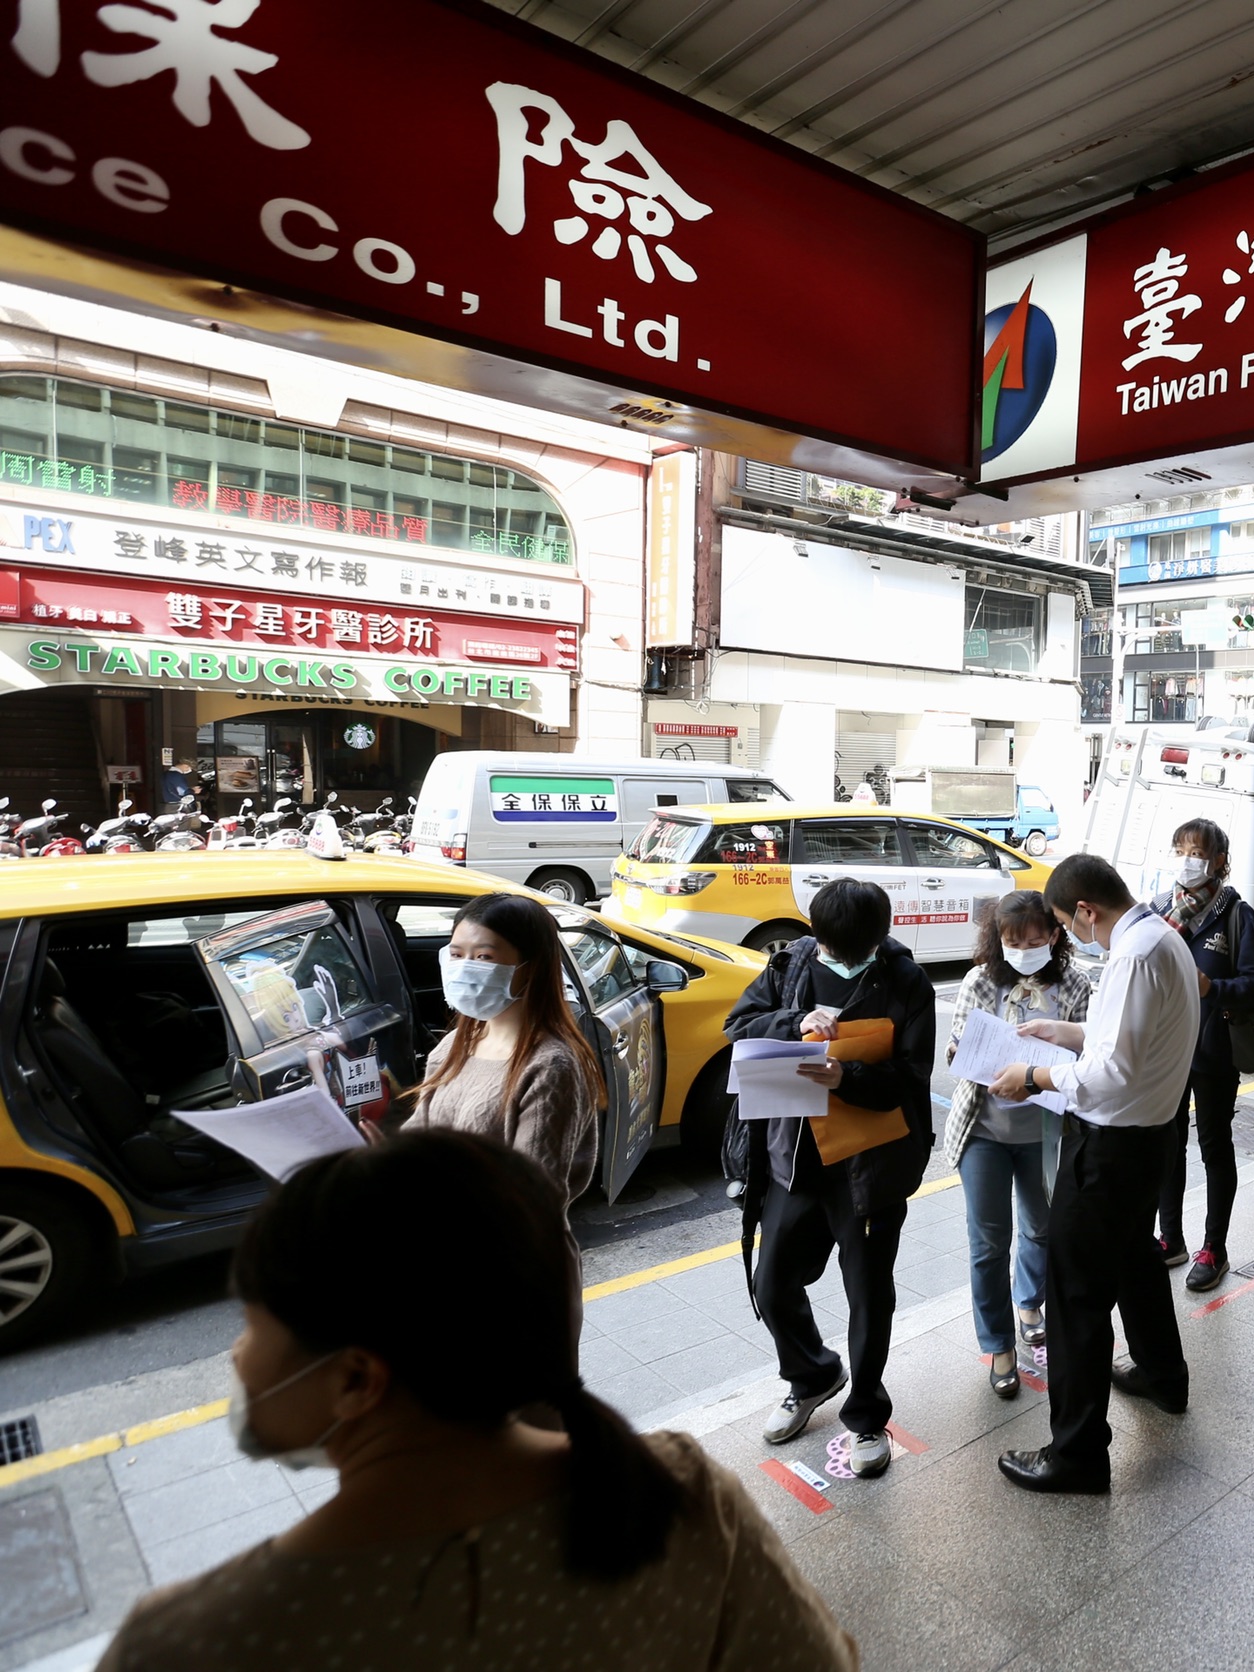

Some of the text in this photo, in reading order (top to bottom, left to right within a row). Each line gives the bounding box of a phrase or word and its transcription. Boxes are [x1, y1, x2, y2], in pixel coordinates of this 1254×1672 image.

[260, 199, 480, 315] Co.,
[545, 278, 711, 372] Ltd.
[1117, 366, 1228, 416] Taiwan
[113, 529, 368, 588] 登峰英文寫作報
[470, 530, 569, 563] 全民健保
[165, 590, 436, 650] 雙子星牙醫診所
[27, 639, 532, 700] STARBUCKS COFFEE
[733, 843, 756, 852] 1912
[733, 873, 767, 886] 166-2C
[894, 899, 969, 913] 遠傳智慧音箱
